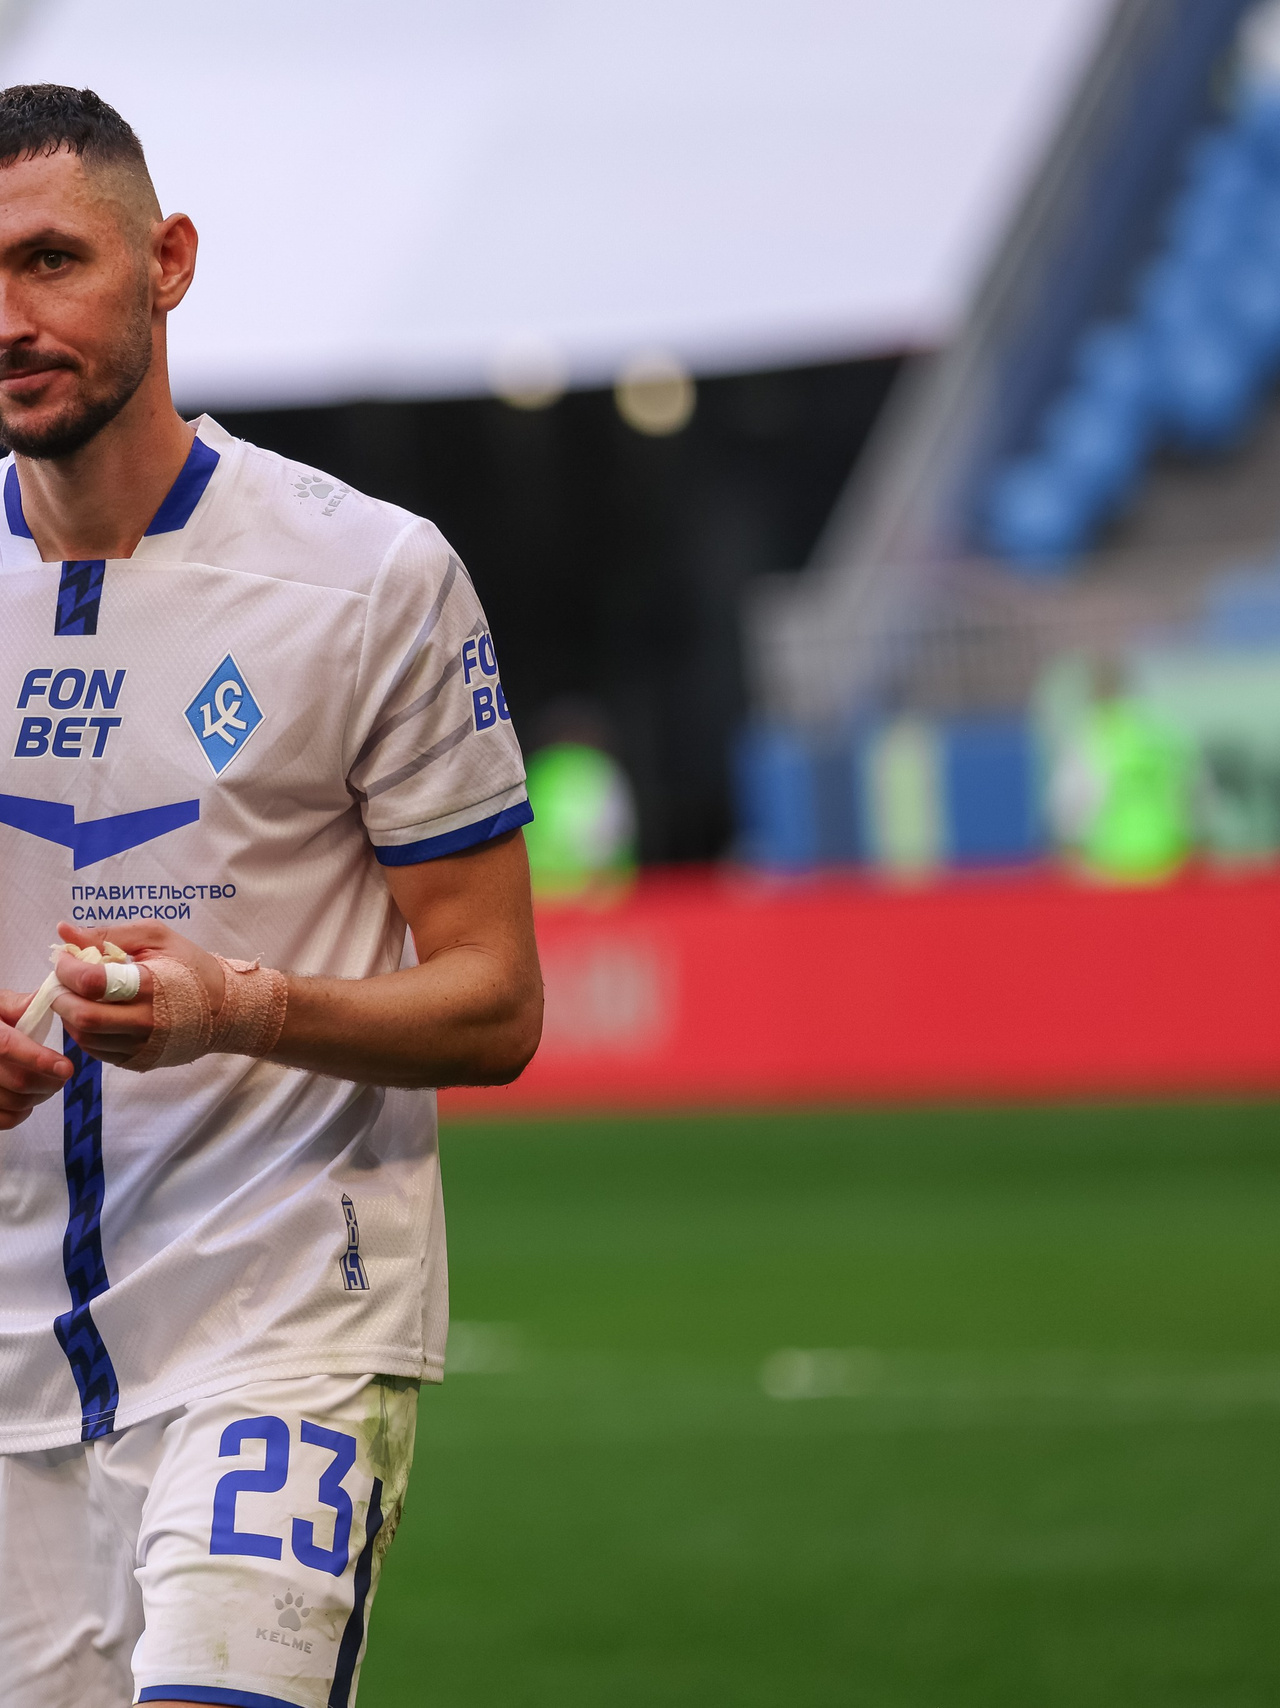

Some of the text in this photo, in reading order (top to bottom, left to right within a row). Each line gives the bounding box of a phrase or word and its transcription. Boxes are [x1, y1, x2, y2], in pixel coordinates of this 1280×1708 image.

[321, 487, 354, 517] KEL
[462, 632, 497, 685] FO
[16, 668, 126, 710] FON
[14, 716, 122, 758] BET
[72, 884, 237, 900] ПРАВИТЕЛЬСТВО
[72, 902, 191, 921] САМАРСКОЙ
[209, 1415, 357, 1578] 23
[255, 1627, 313, 1655] KELME
